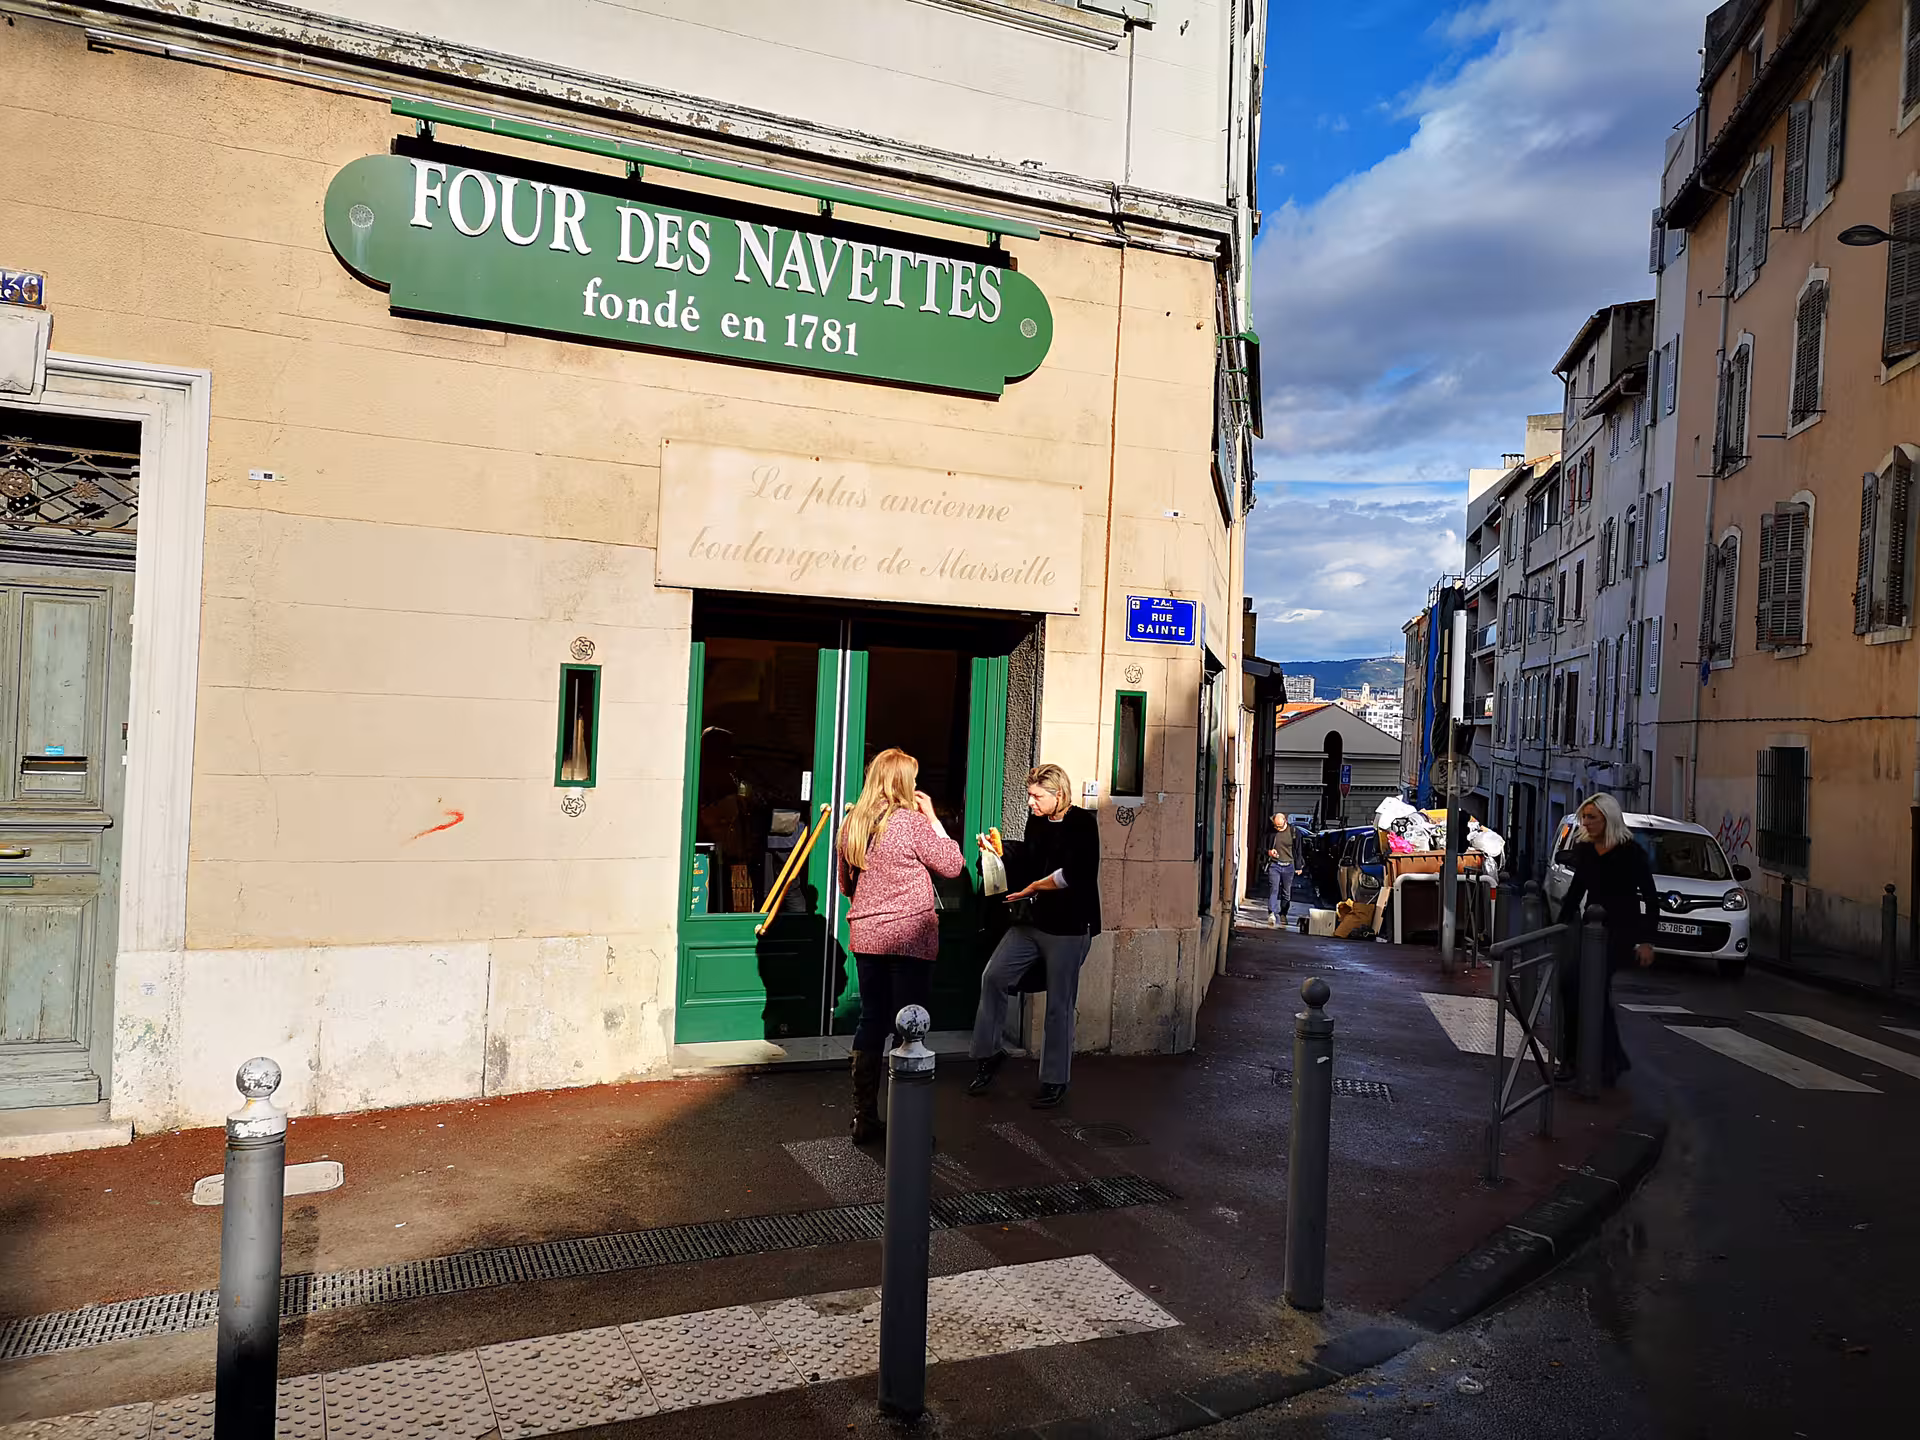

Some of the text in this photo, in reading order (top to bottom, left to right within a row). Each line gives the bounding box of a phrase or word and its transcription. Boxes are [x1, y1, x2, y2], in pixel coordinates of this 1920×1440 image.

[410, 159, 1002, 323] FOUR DES NAVETTES
[583, 277, 859, 357] fondé en 1781
[752, 465, 1011, 522] La plus ancienne
[688, 526, 1056, 586] boulangerie de Marseille
[1137, 624, 1185, 635] SAINTE
[1152, 613, 1172, 622] RUE
